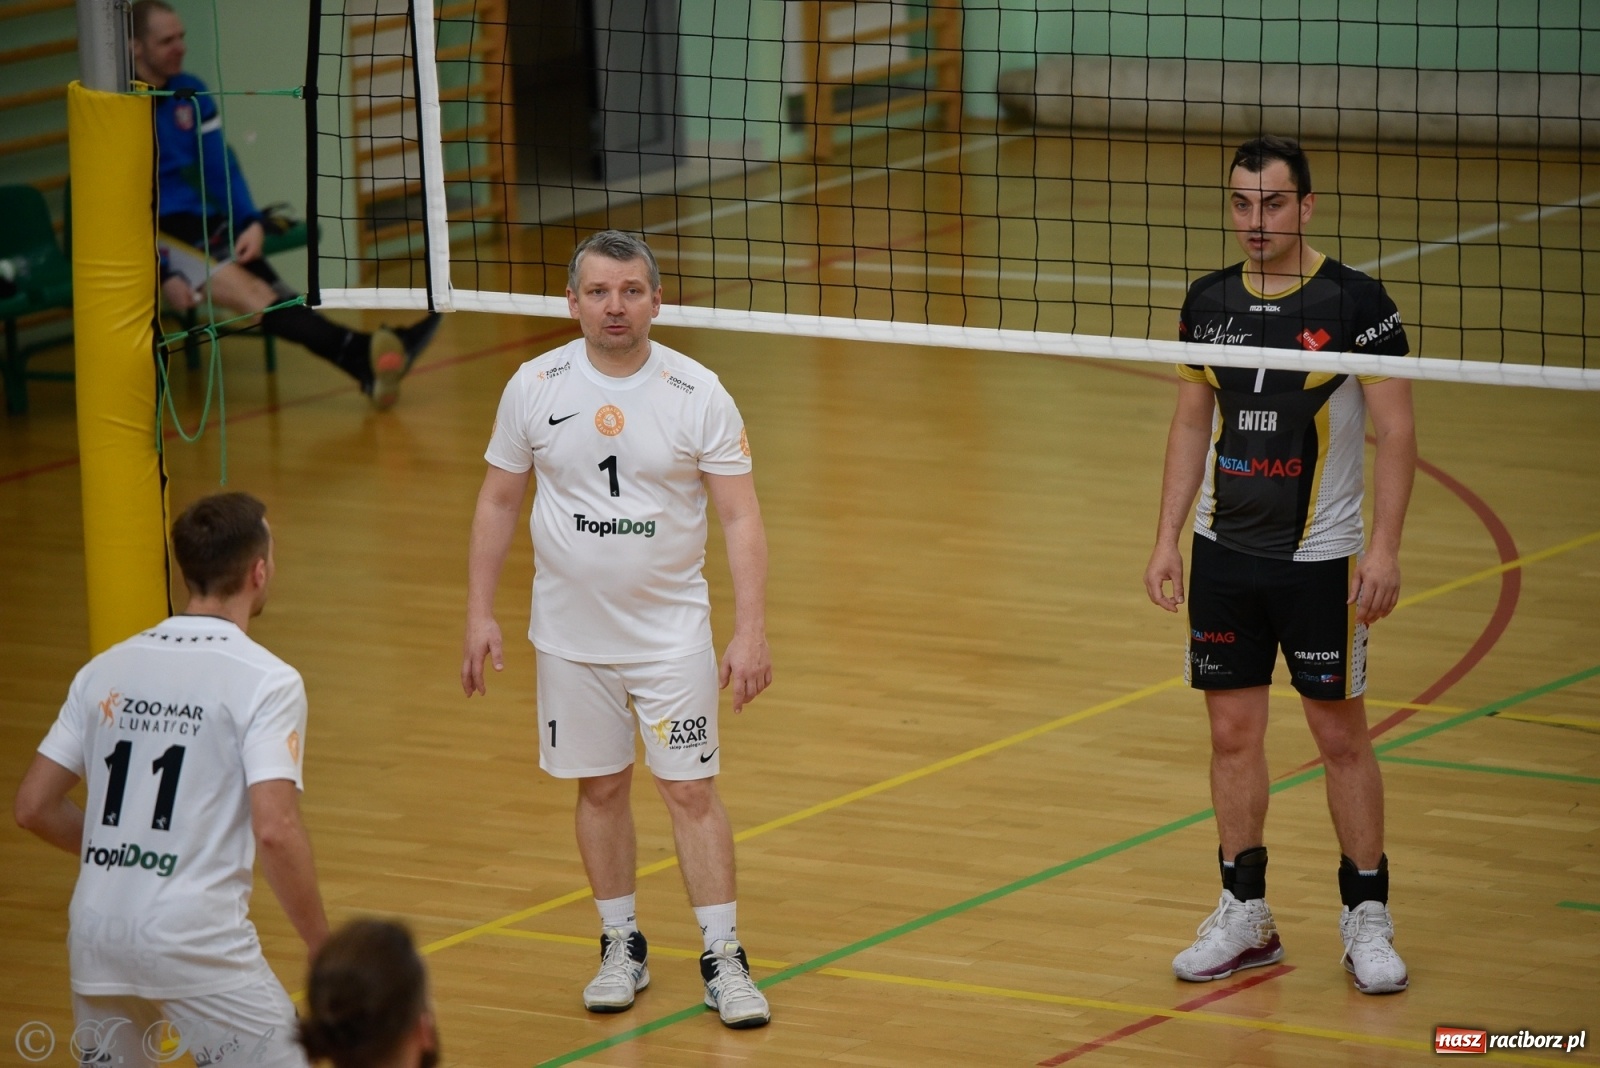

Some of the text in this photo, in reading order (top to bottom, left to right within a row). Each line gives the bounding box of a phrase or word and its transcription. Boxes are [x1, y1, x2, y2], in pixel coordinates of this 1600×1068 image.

[1238, 410, 1278, 432] ENTER
[598, 455, 620, 497] 1
[573, 513, 656, 537] TropiDog
[548, 719, 557, 748] 1
[670, 716, 707, 732] ZOO
[668, 728, 708, 745] MAR
[101, 739, 187, 831] 11
